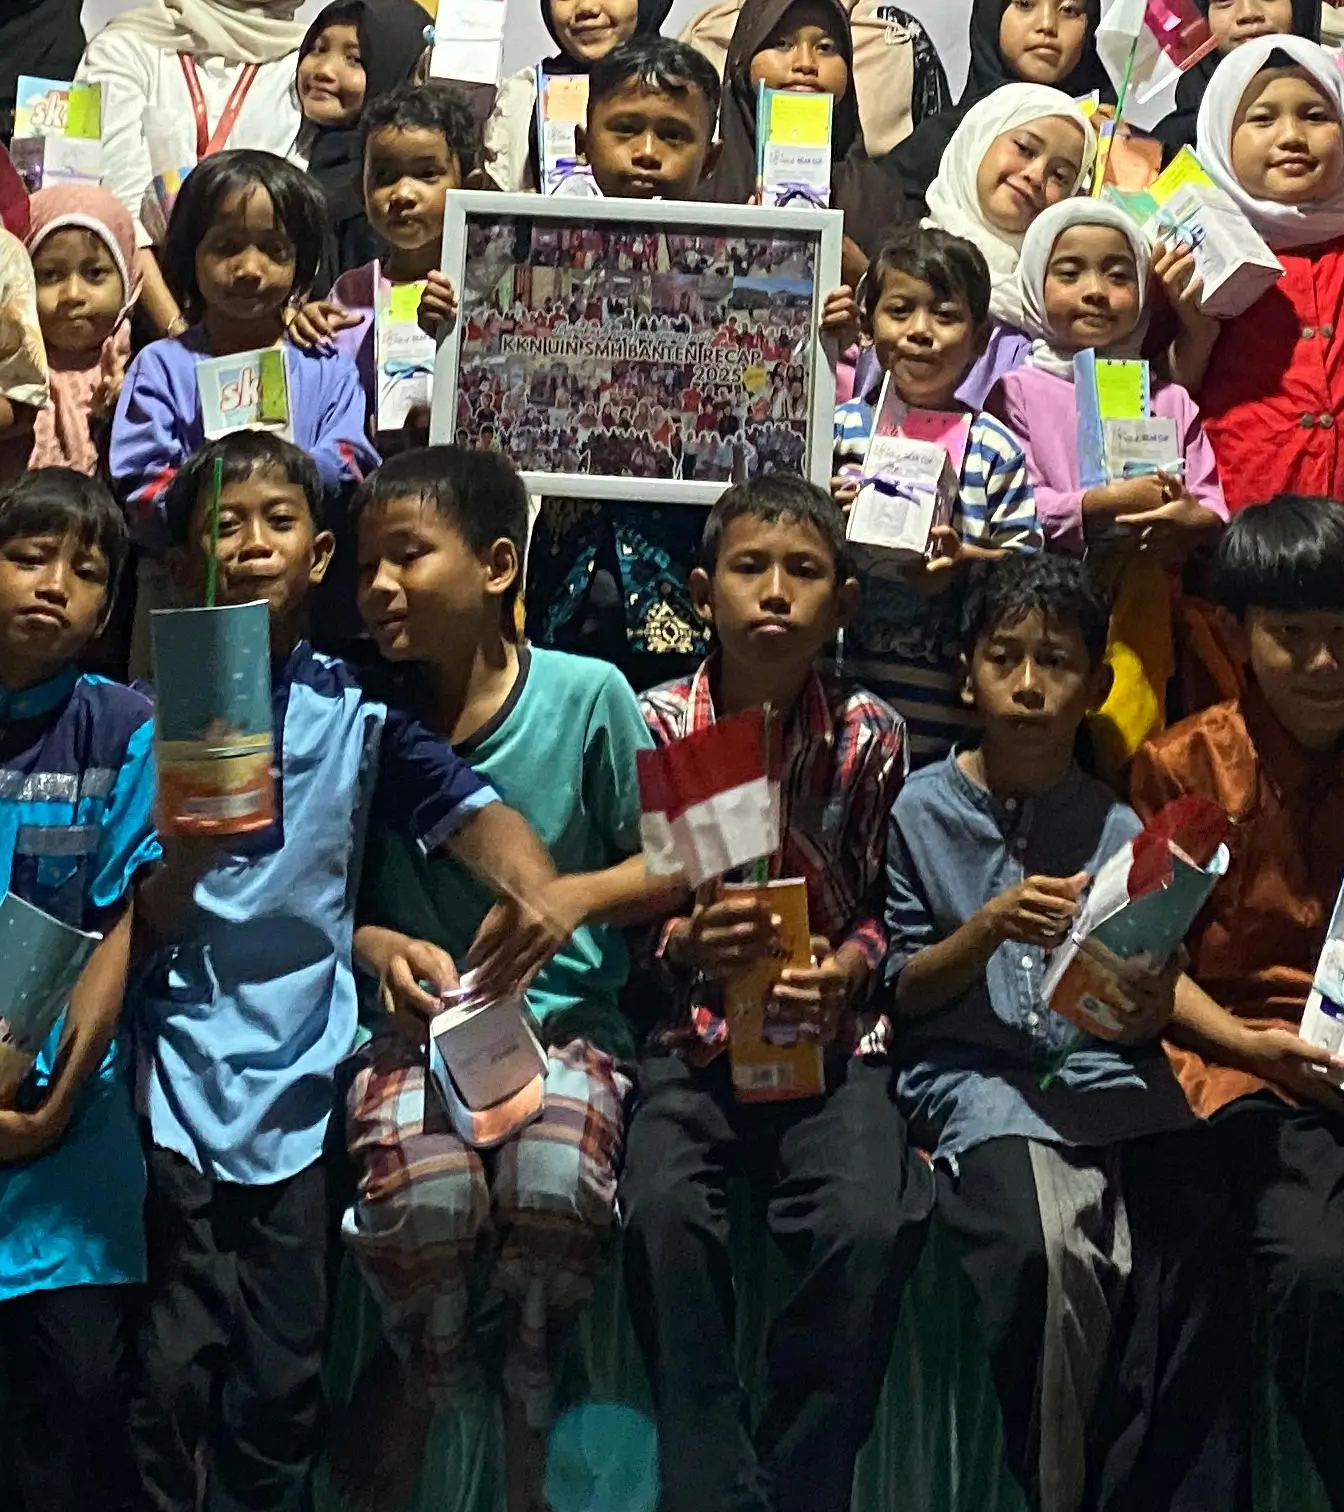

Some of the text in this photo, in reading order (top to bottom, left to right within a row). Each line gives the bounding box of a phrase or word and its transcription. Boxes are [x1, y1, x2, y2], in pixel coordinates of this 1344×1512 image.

[30, 91, 68, 128] sk
[504, 337, 762, 365] KKN UIN SMH BANTEN RECAP
[220, 364, 261, 413] sk
[694, 366, 742, 383] 2025
